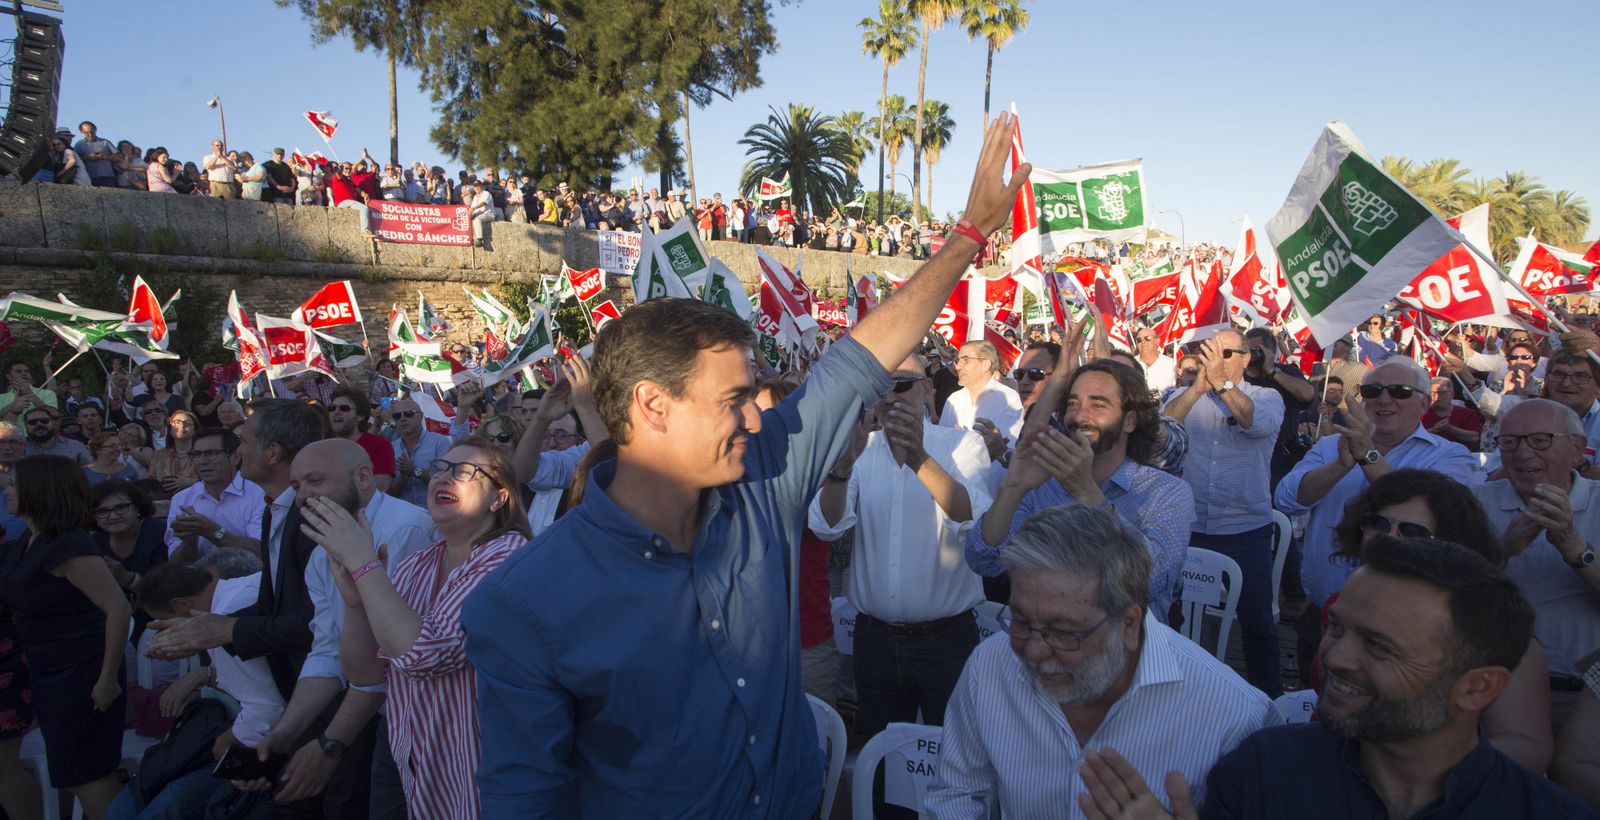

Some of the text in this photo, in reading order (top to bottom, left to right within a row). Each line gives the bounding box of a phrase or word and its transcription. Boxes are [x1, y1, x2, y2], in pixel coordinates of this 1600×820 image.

[381, 203, 441, 217] SOCIALISTAS
[405, 223, 422, 231] CON
[420, 216, 452, 225] VICTORIA
[375, 230, 470, 244] PEDRO SÁNCHEZ
[617, 234, 626, 245] EL
[617, 246, 640, 258] PEDRO
[1292, 239, 1352, 299] PSOE
[574, 272, 601, 297] PSOE
[1522, 268, 1588, 290] PSOE
[1397, 264, 1483, 310] SOE
[304, 302, 352, 323] PSOE
[819, 309, 847, 321] PSOE
[270, 342, 305, 358] PSOE
